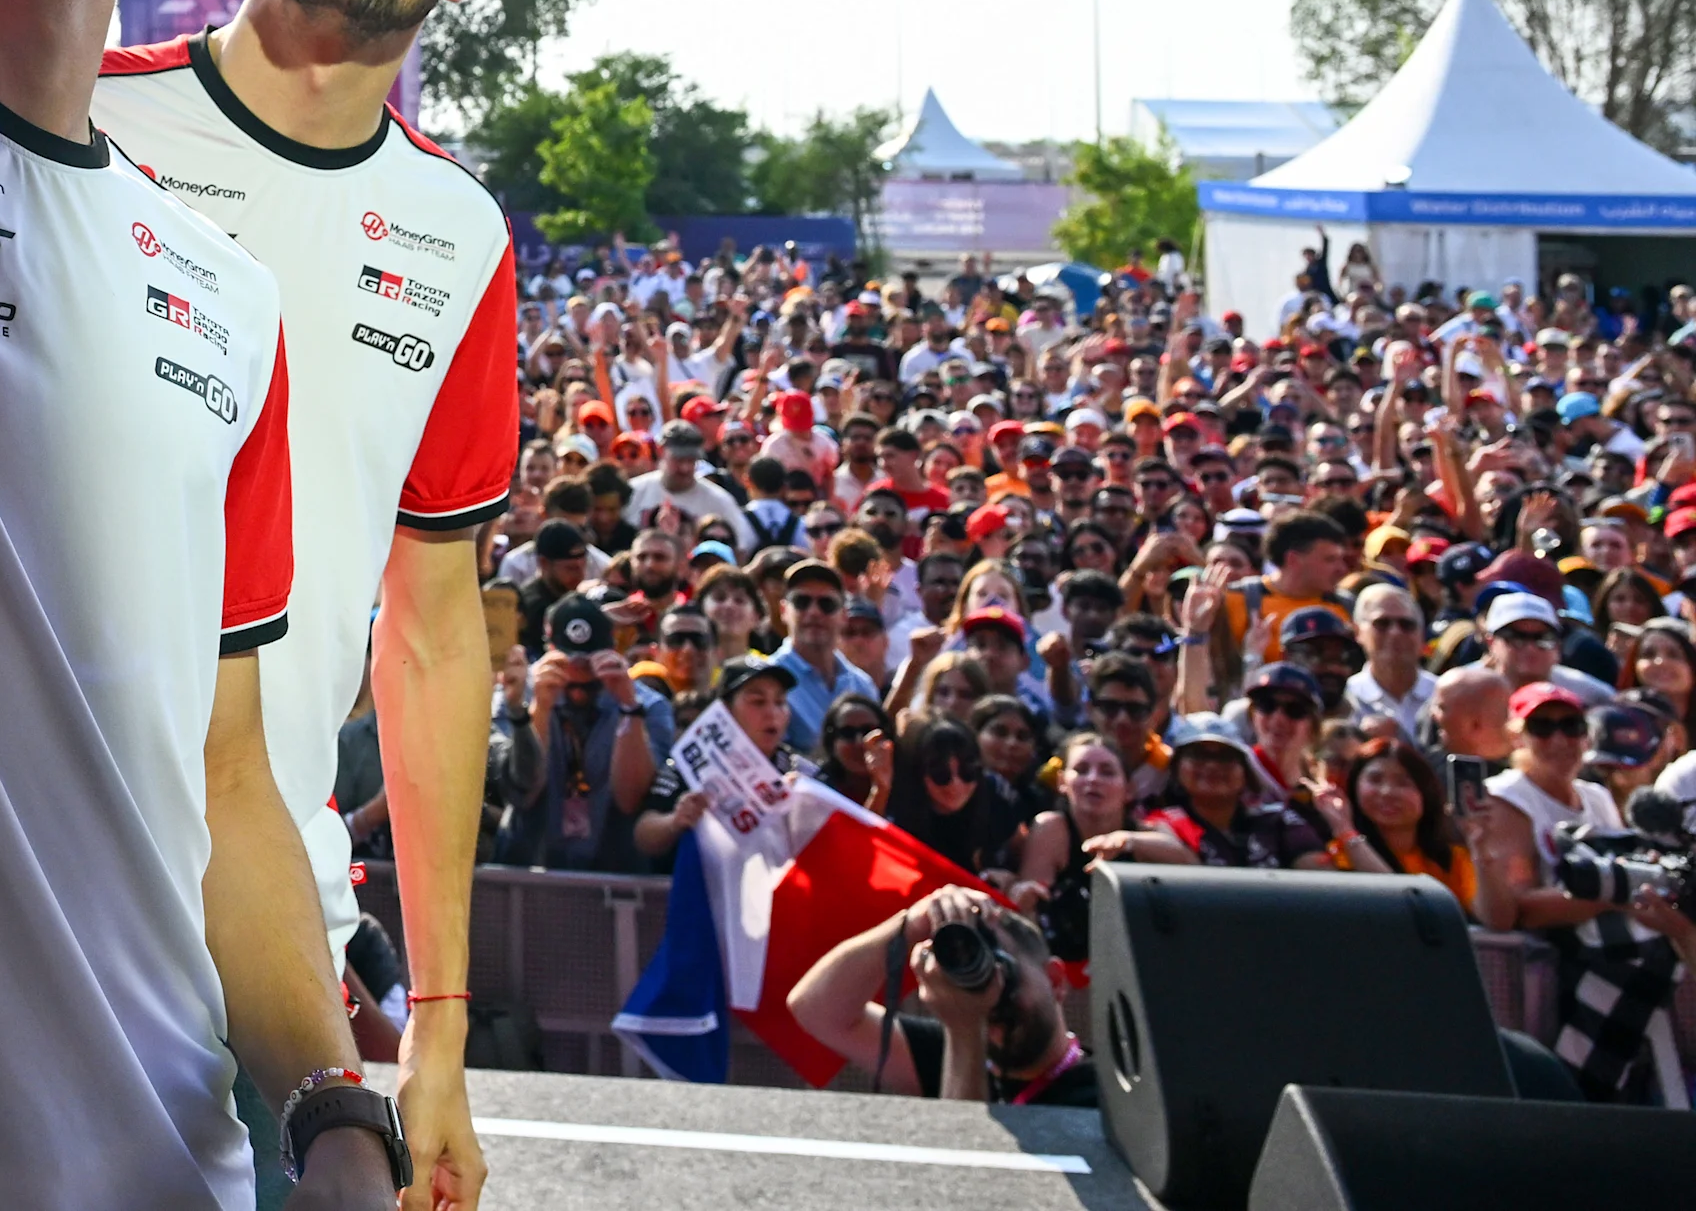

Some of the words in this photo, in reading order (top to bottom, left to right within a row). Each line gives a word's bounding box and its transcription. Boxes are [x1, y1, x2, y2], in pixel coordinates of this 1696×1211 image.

[160, 175, 246, 201] MoneyGram
[389, 222, 455, 251] MoneyGram
[429, 248, 456, 262] TEAM
[194, 276, 220, 295] TEAM
[358, 269, 402, 300] GR
[404, 287, 445, 308] GAZOO
[407, 277, 451, 300] TOYOTA
[147, 291, 190, 329] GR
[402, 296, 442, 317] Racing
[191, 305, 230, 338] TOYOTA
[193, 316, 228, 344] GAZOO
[193, 325, 228, 356] Racing
[356, 326, 395, 353] PLAY'n
[394, 335, 432, 371] GO
[160, 360, 205, 395] PLAY'n
[205, 375, 236, 423] GO
